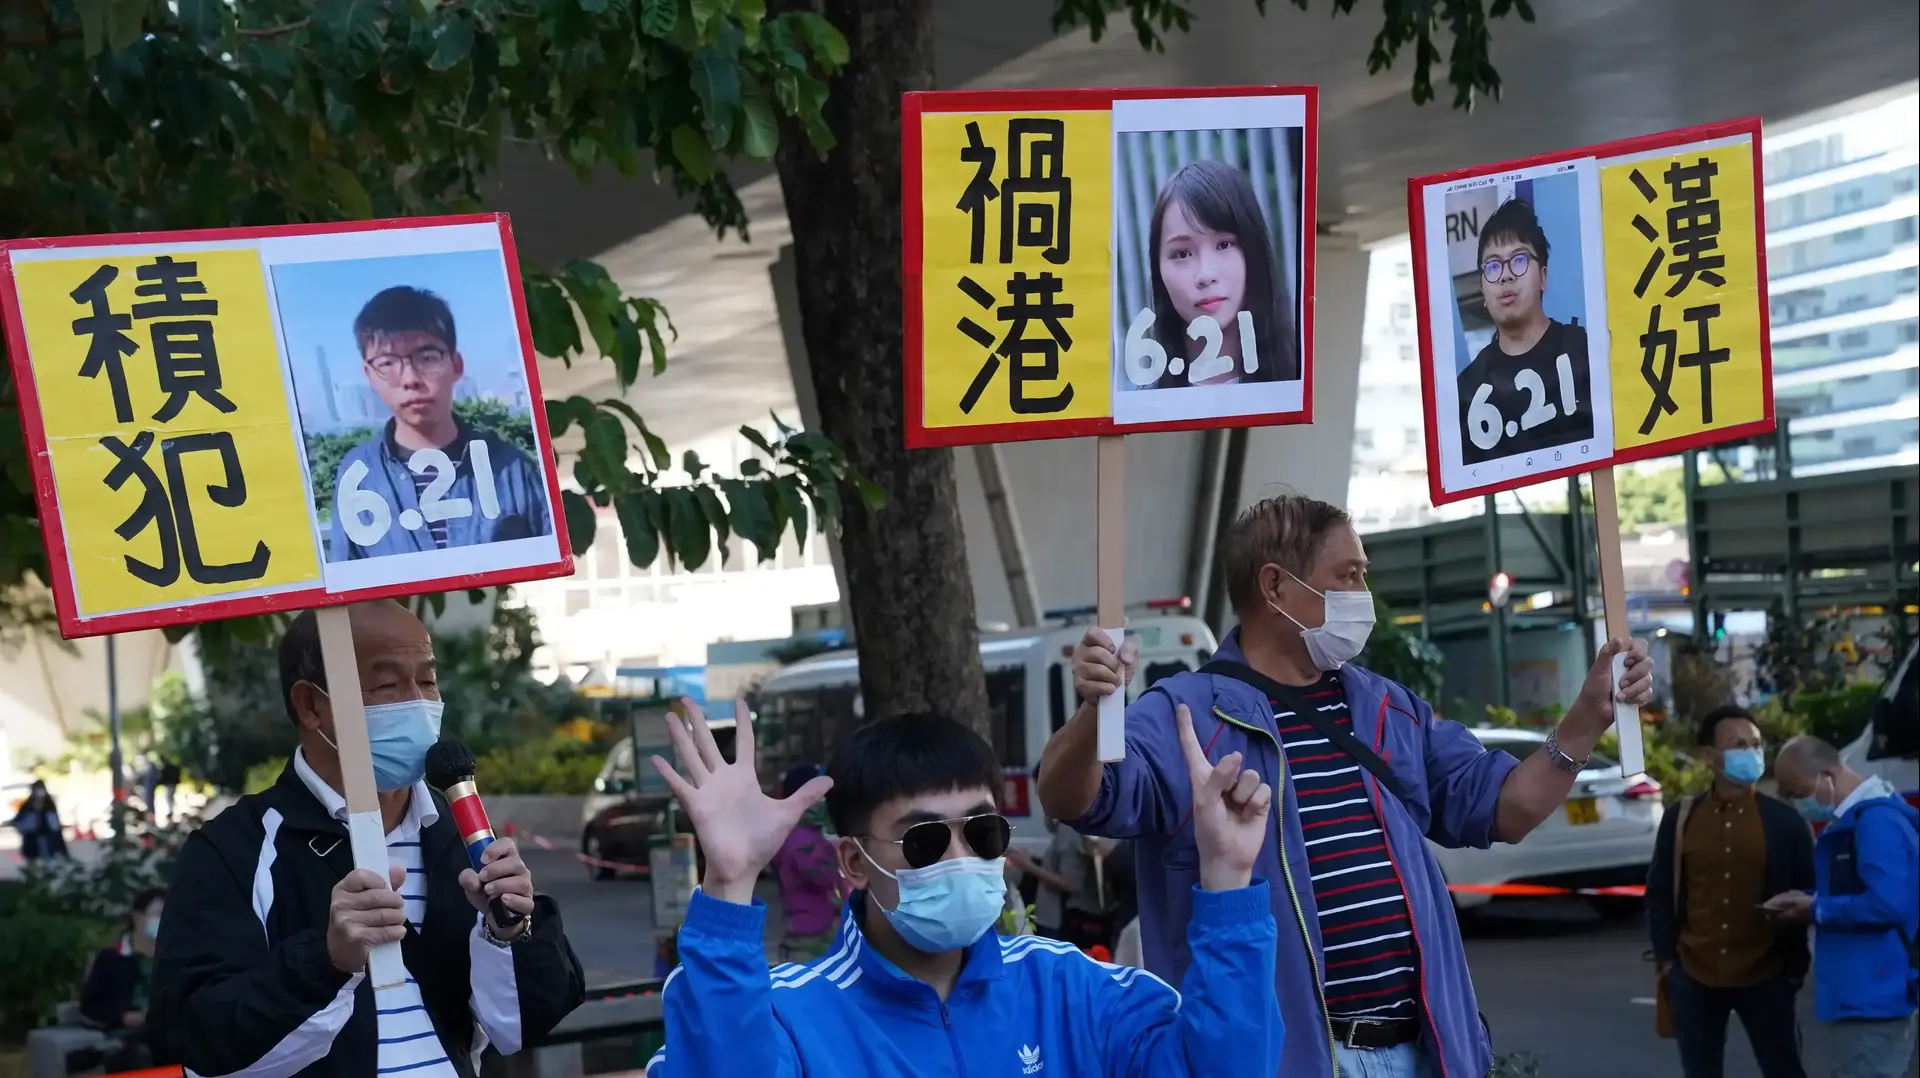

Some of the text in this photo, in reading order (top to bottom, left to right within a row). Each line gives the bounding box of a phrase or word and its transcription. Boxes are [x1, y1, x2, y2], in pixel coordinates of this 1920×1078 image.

[956, 118, 1074, 415] 禍港
[1628, 157, 1730, 436] 漢奸
[1125, 307, 1259, 386] 6.21
[70, 256, 271, 587] 積犯
[1467, 353, 1578, 450] 6.21
[337, 440, 500, 547] 6.21
[1022, 1060, 1044, 1075] dida
